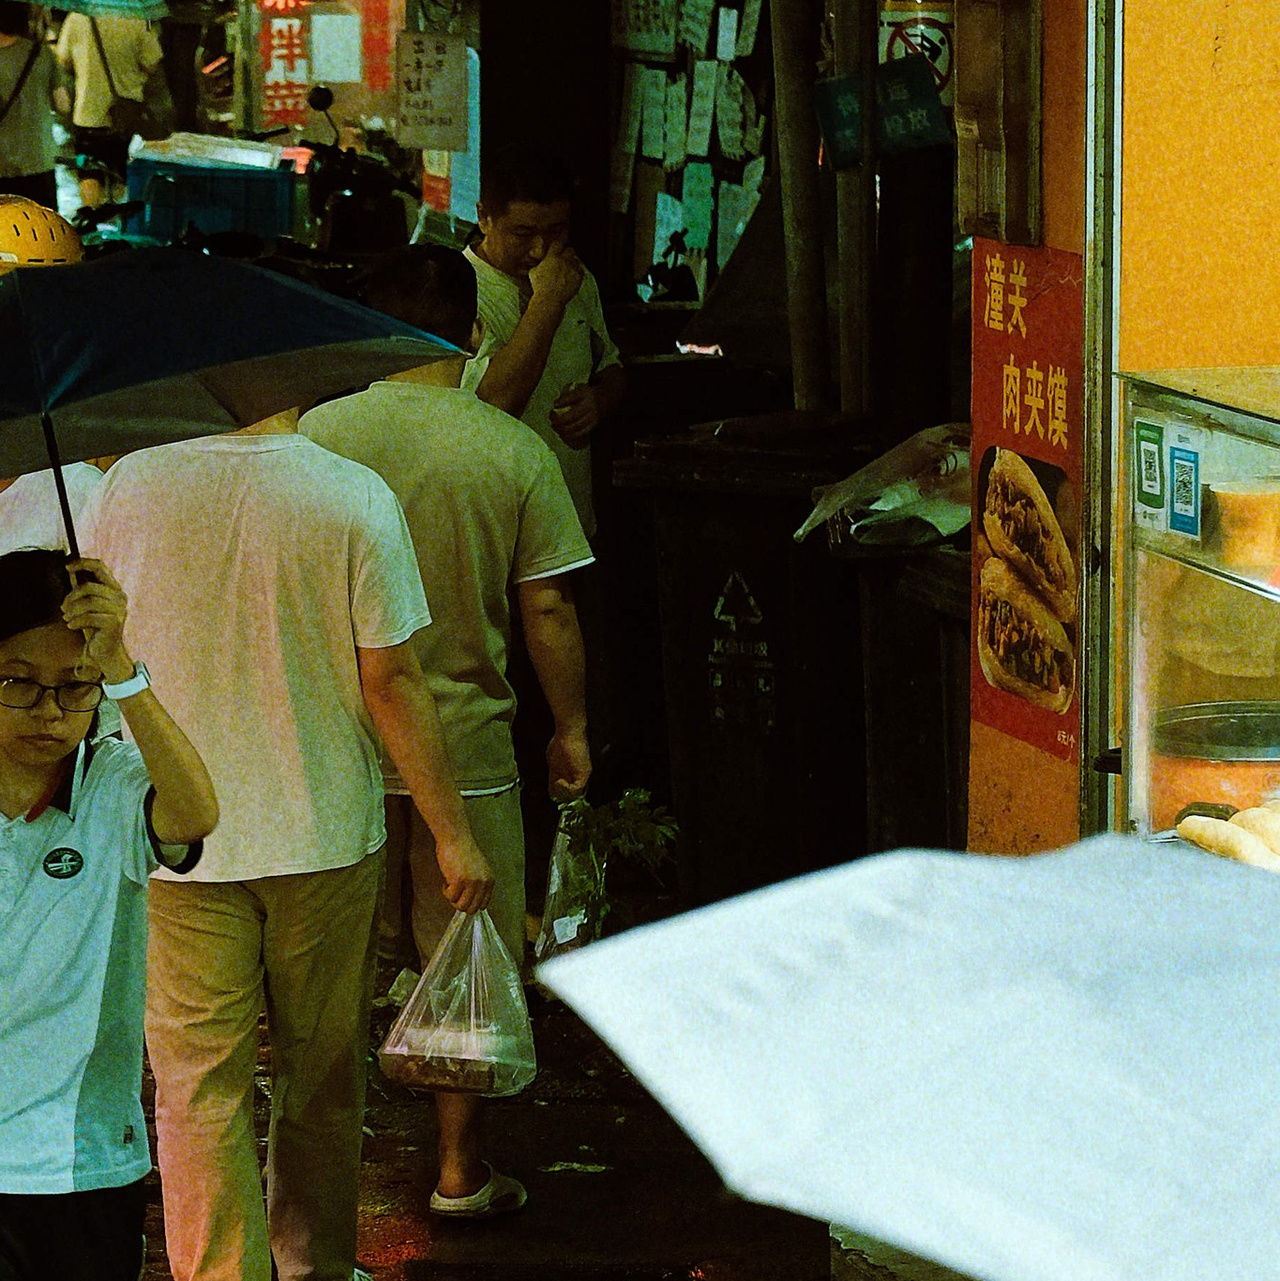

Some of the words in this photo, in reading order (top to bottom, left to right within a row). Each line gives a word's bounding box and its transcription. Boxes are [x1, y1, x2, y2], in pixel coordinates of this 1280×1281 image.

[983, 252, 1028, 340] 潼关
[1002, 352, 1069, 451] 肉夹馍
